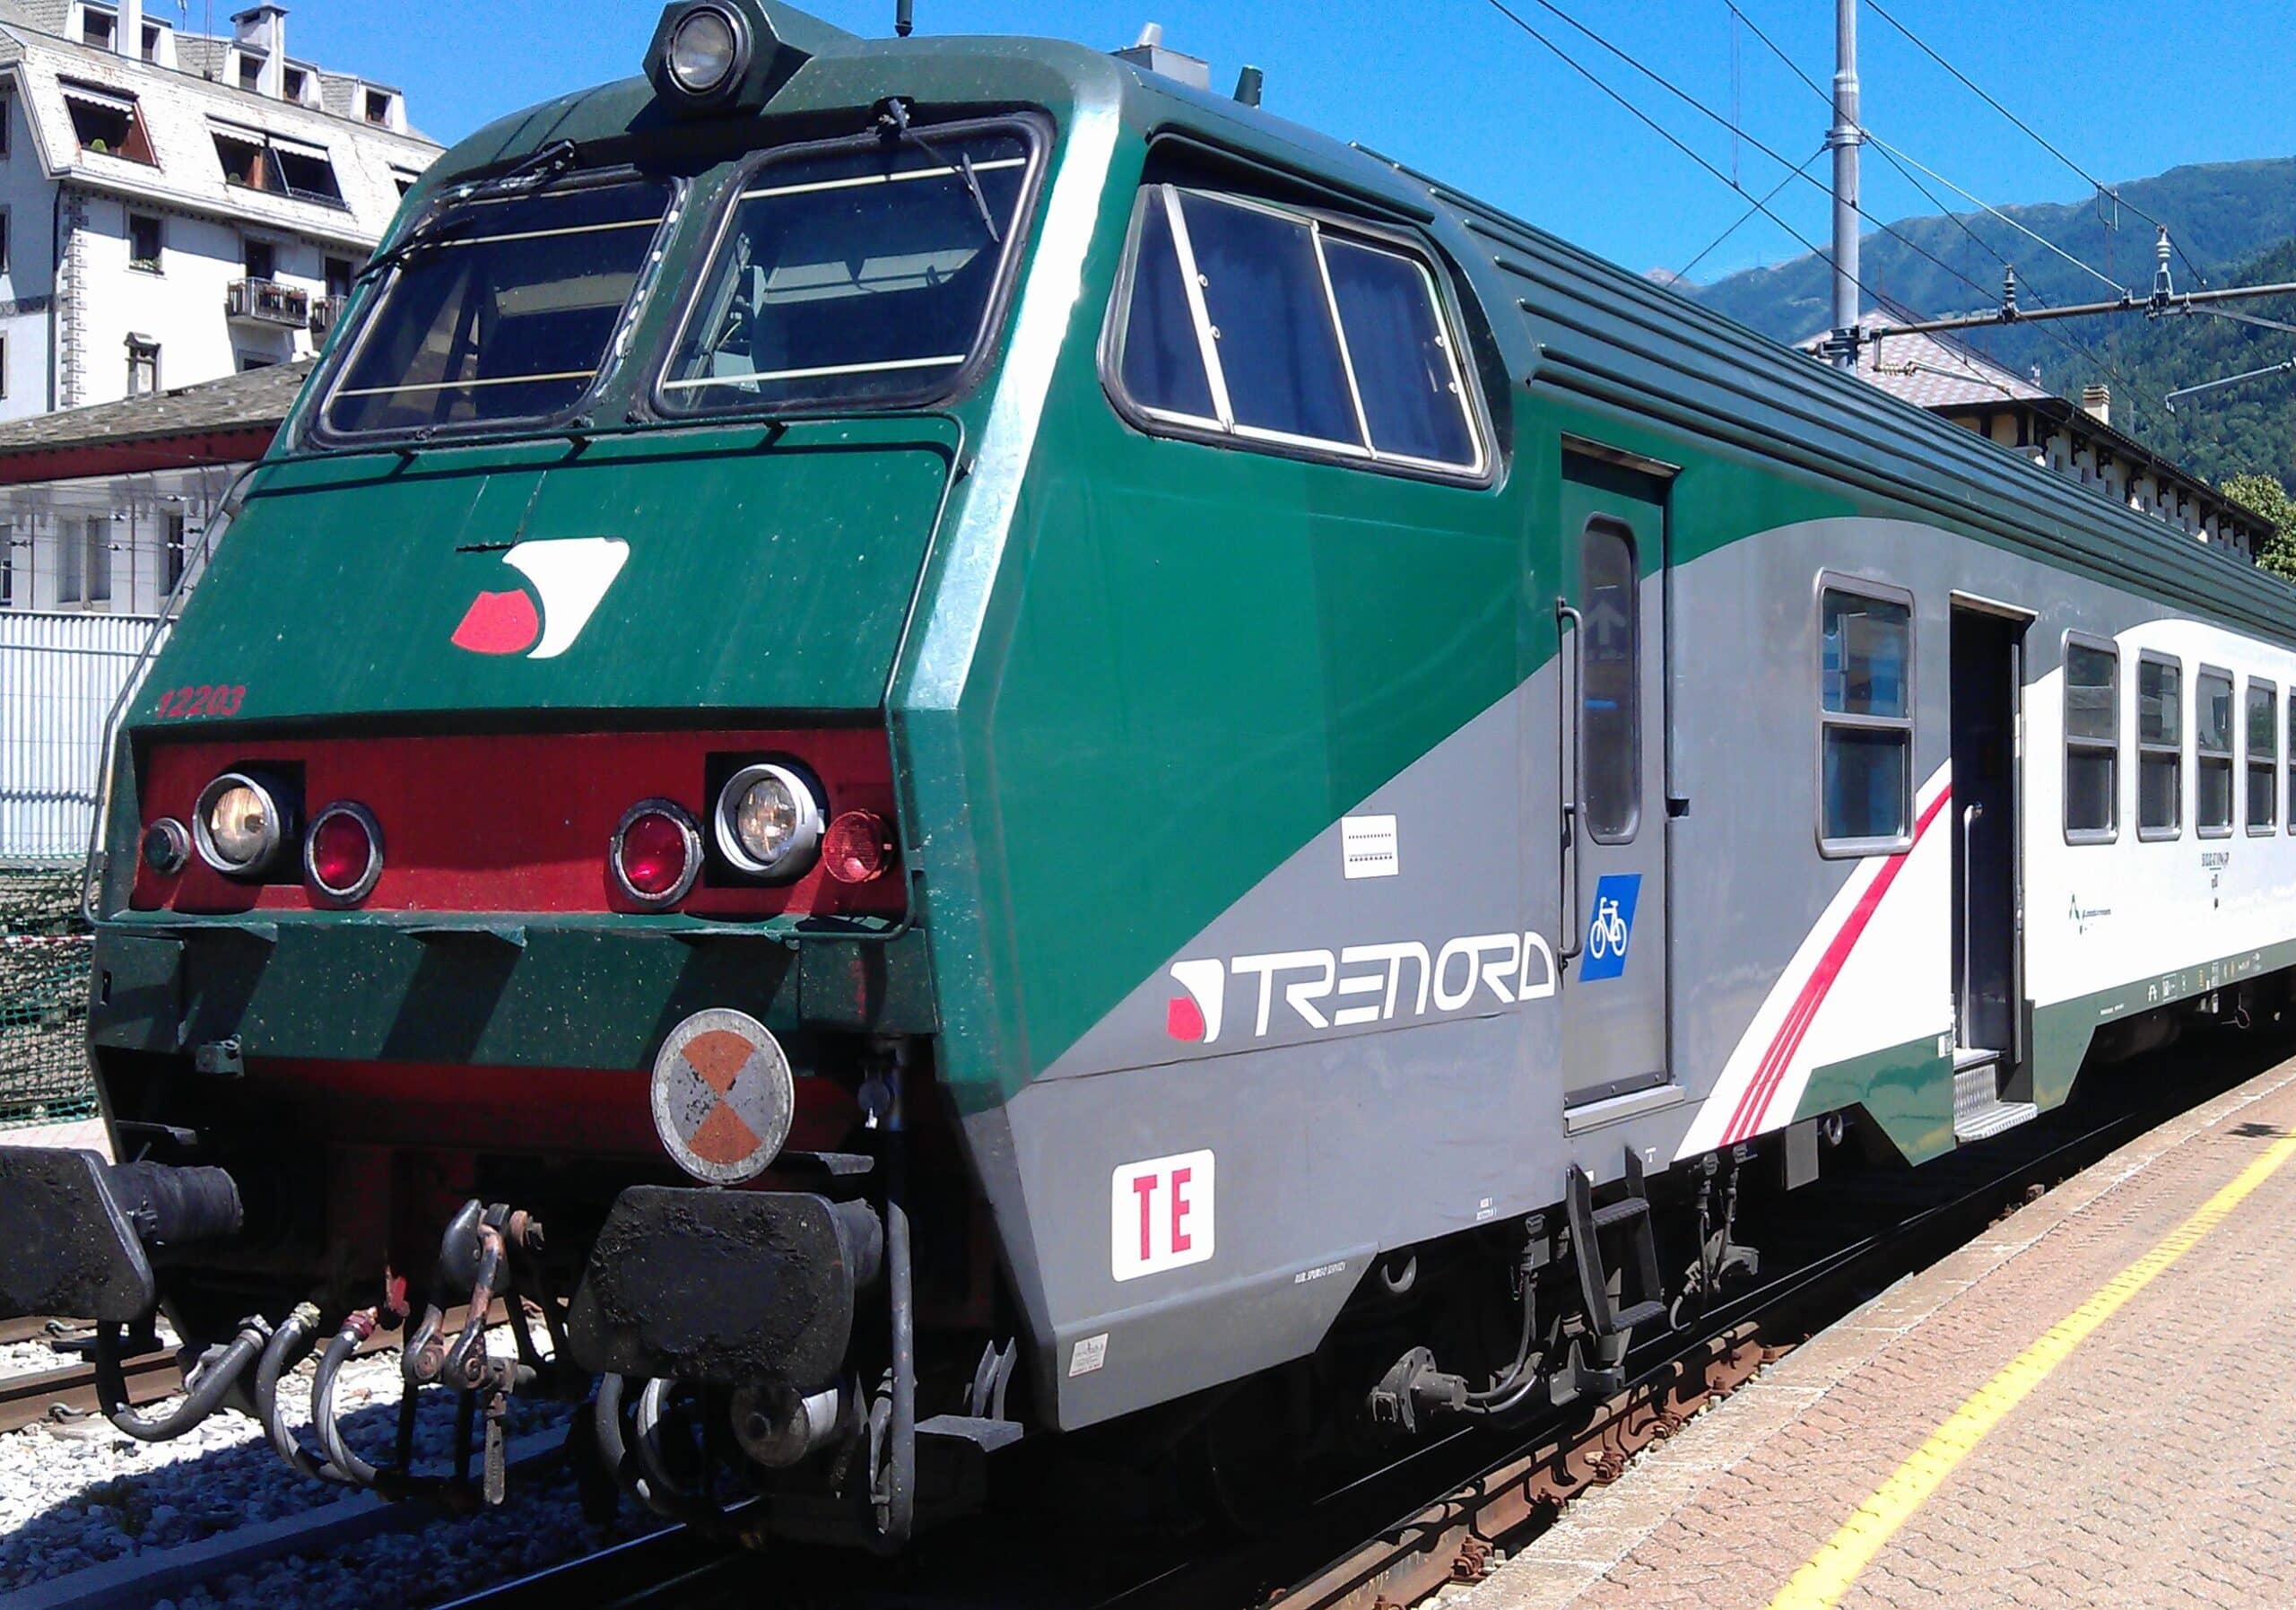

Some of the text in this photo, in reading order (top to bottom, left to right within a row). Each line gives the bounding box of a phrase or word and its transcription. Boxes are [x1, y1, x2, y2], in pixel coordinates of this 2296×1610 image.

[156, 683, 246, 718] 12203
[1231, 931, 1556, 1037] TRENORD
[1133, 1167, 1191, 1261] TE
